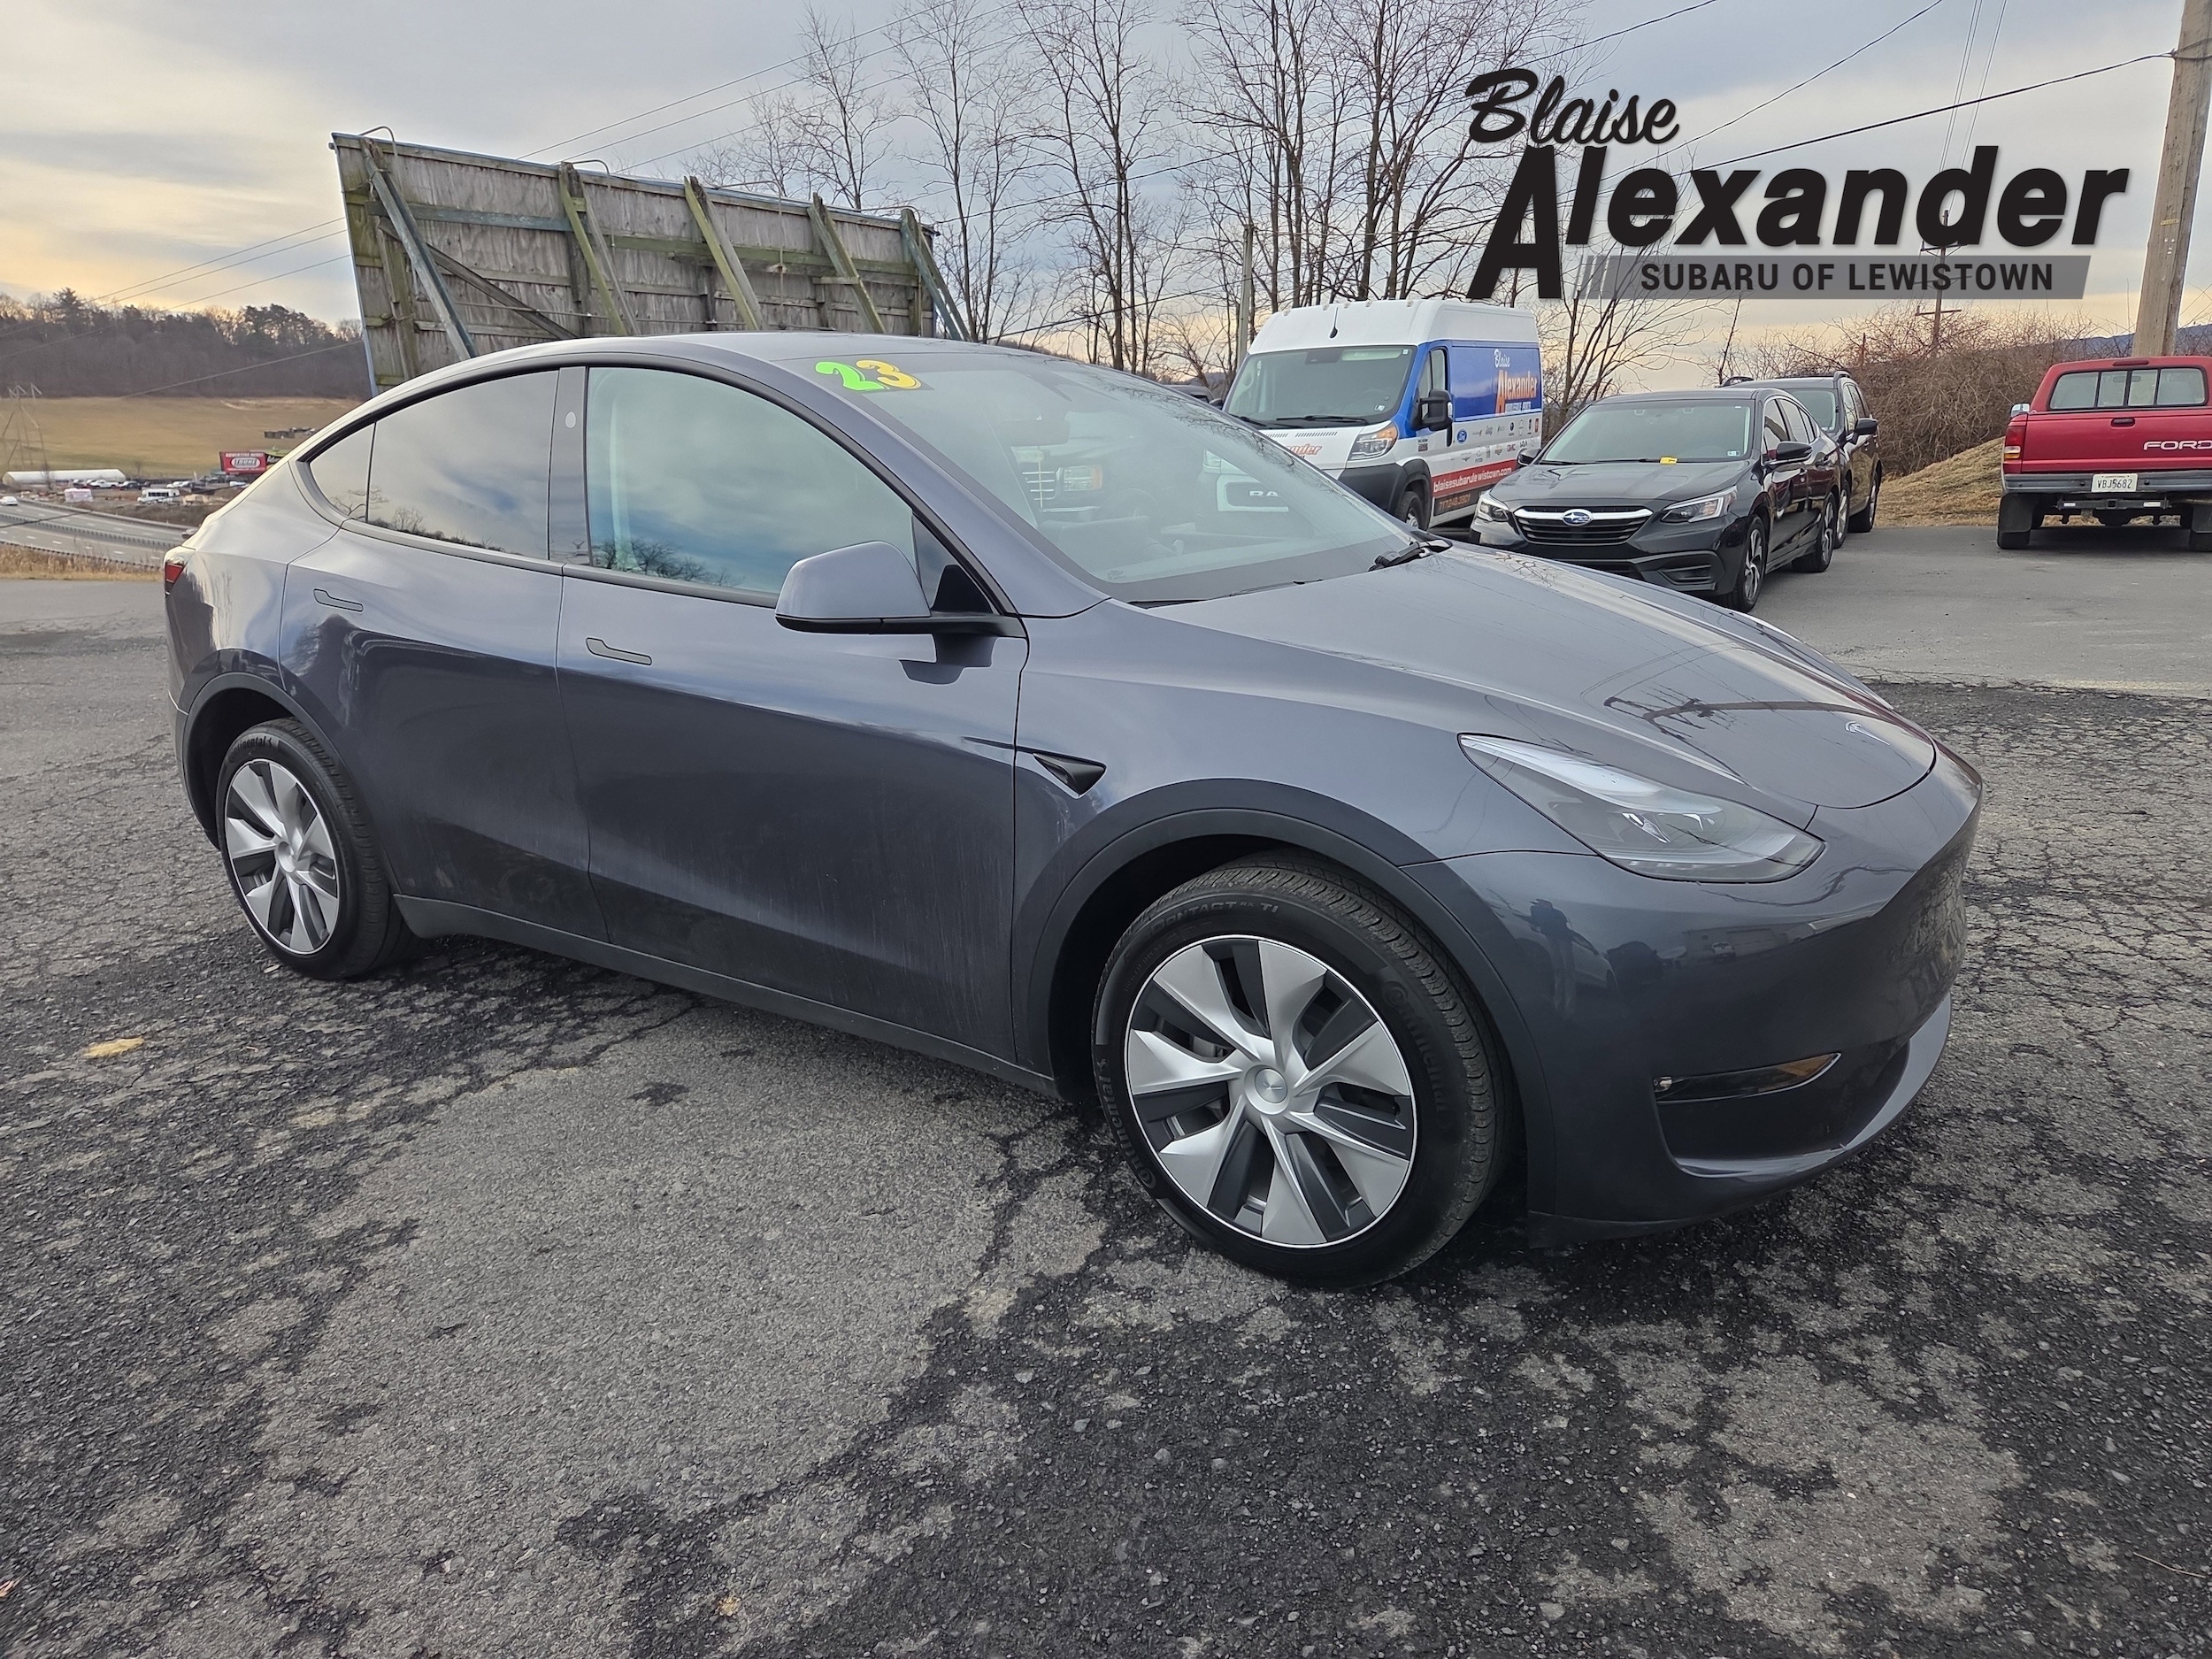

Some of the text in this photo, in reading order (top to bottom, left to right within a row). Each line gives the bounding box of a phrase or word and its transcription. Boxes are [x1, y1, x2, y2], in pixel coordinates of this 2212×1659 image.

[814, 359, 922, 391] 23
[1495, 369, 1538, 416] Alexander
[2143, 440, 2212, 450] FORD
